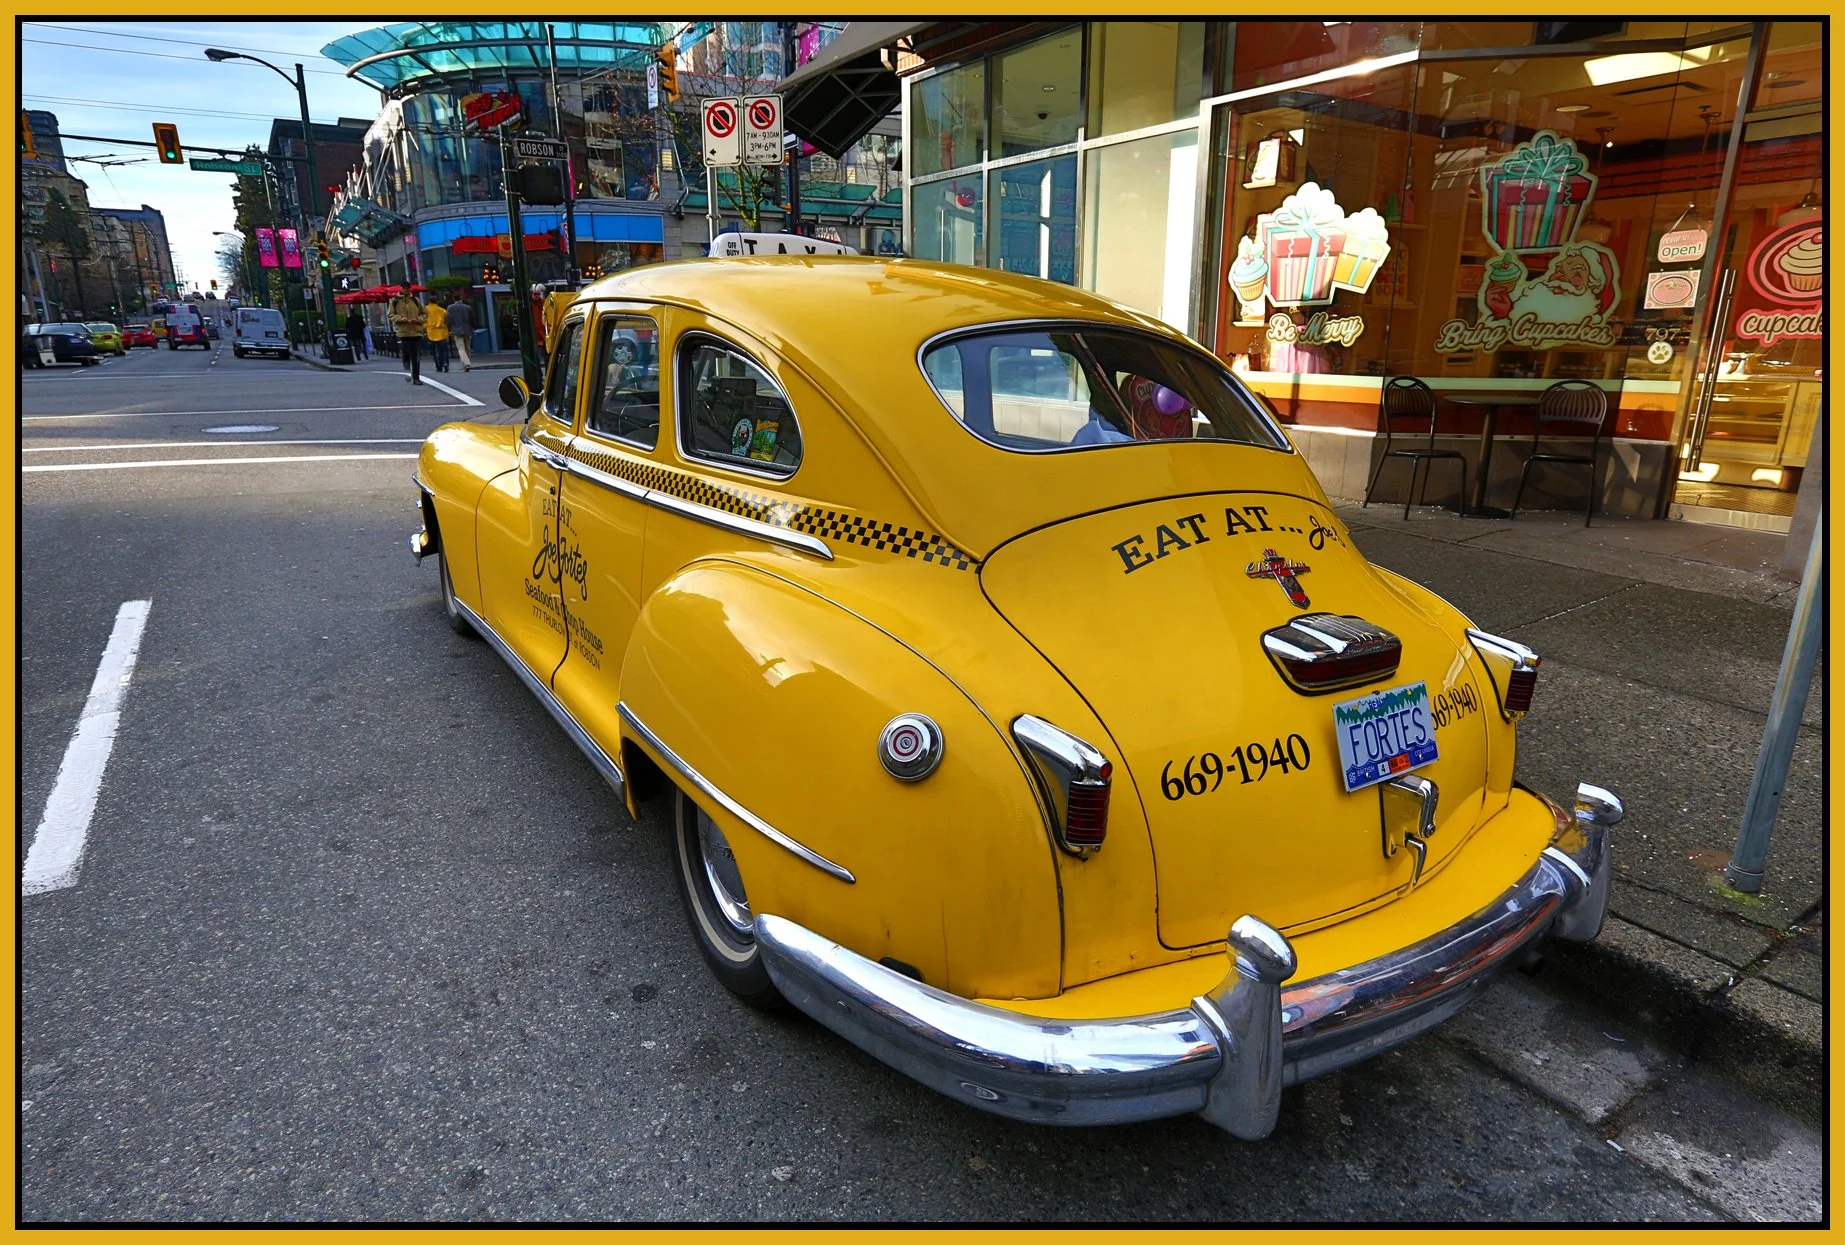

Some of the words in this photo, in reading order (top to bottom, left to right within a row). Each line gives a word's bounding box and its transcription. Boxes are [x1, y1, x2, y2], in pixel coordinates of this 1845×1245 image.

[520, 142, 554, 156] ROBSON
[195, 161, 239, 171] Robson
[243, 163, 257, 173] St
[1268, 314, 1297, 341] Be
[1298, 313, 1362, 345] Merry
[1436, 320, 1509, 350] Bring
[1511, 312, 1615, 347] Cupcakes
[1645, 327, 1681, 341] 797
[542, 498, 557, 517] EAT
[1111, 512, 1211, 575] EAT
[532, 524, 557, 580] Joe
[548, 536, 588, 602] Fortes
[525, 578, 555, 613] Seafood
[532, 604, 542, 619] 777
[1348, 706, 1427, 766] FORTES
[1160, 733, 1311, 801] 669-1940
